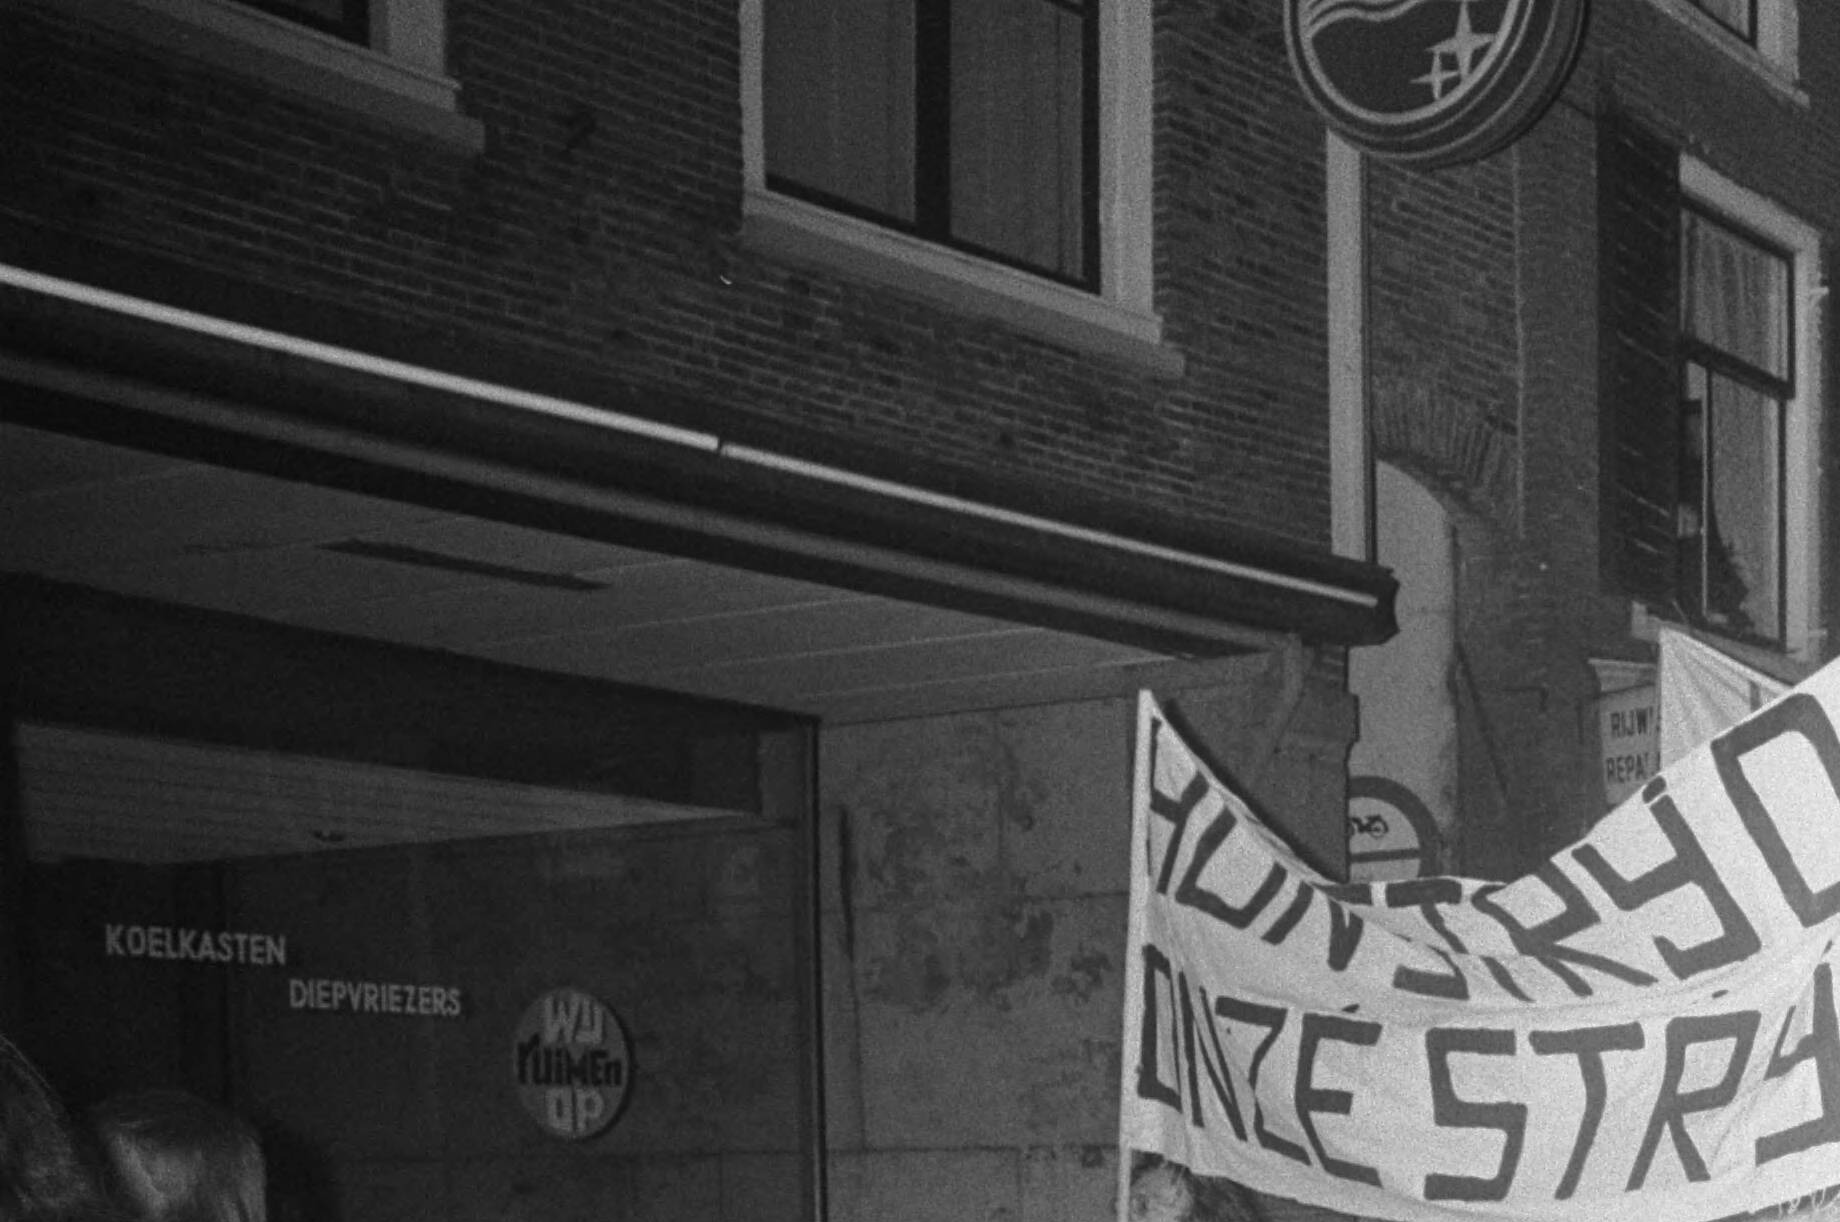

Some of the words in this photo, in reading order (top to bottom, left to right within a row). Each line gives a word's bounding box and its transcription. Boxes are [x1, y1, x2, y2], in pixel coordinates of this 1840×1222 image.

[105, 924, 287, 966] KOELKASTEN
[288, 978, 462, 1016] DIEPVRIEZERS
[1137, 944, 1383, 1189] ONZE
